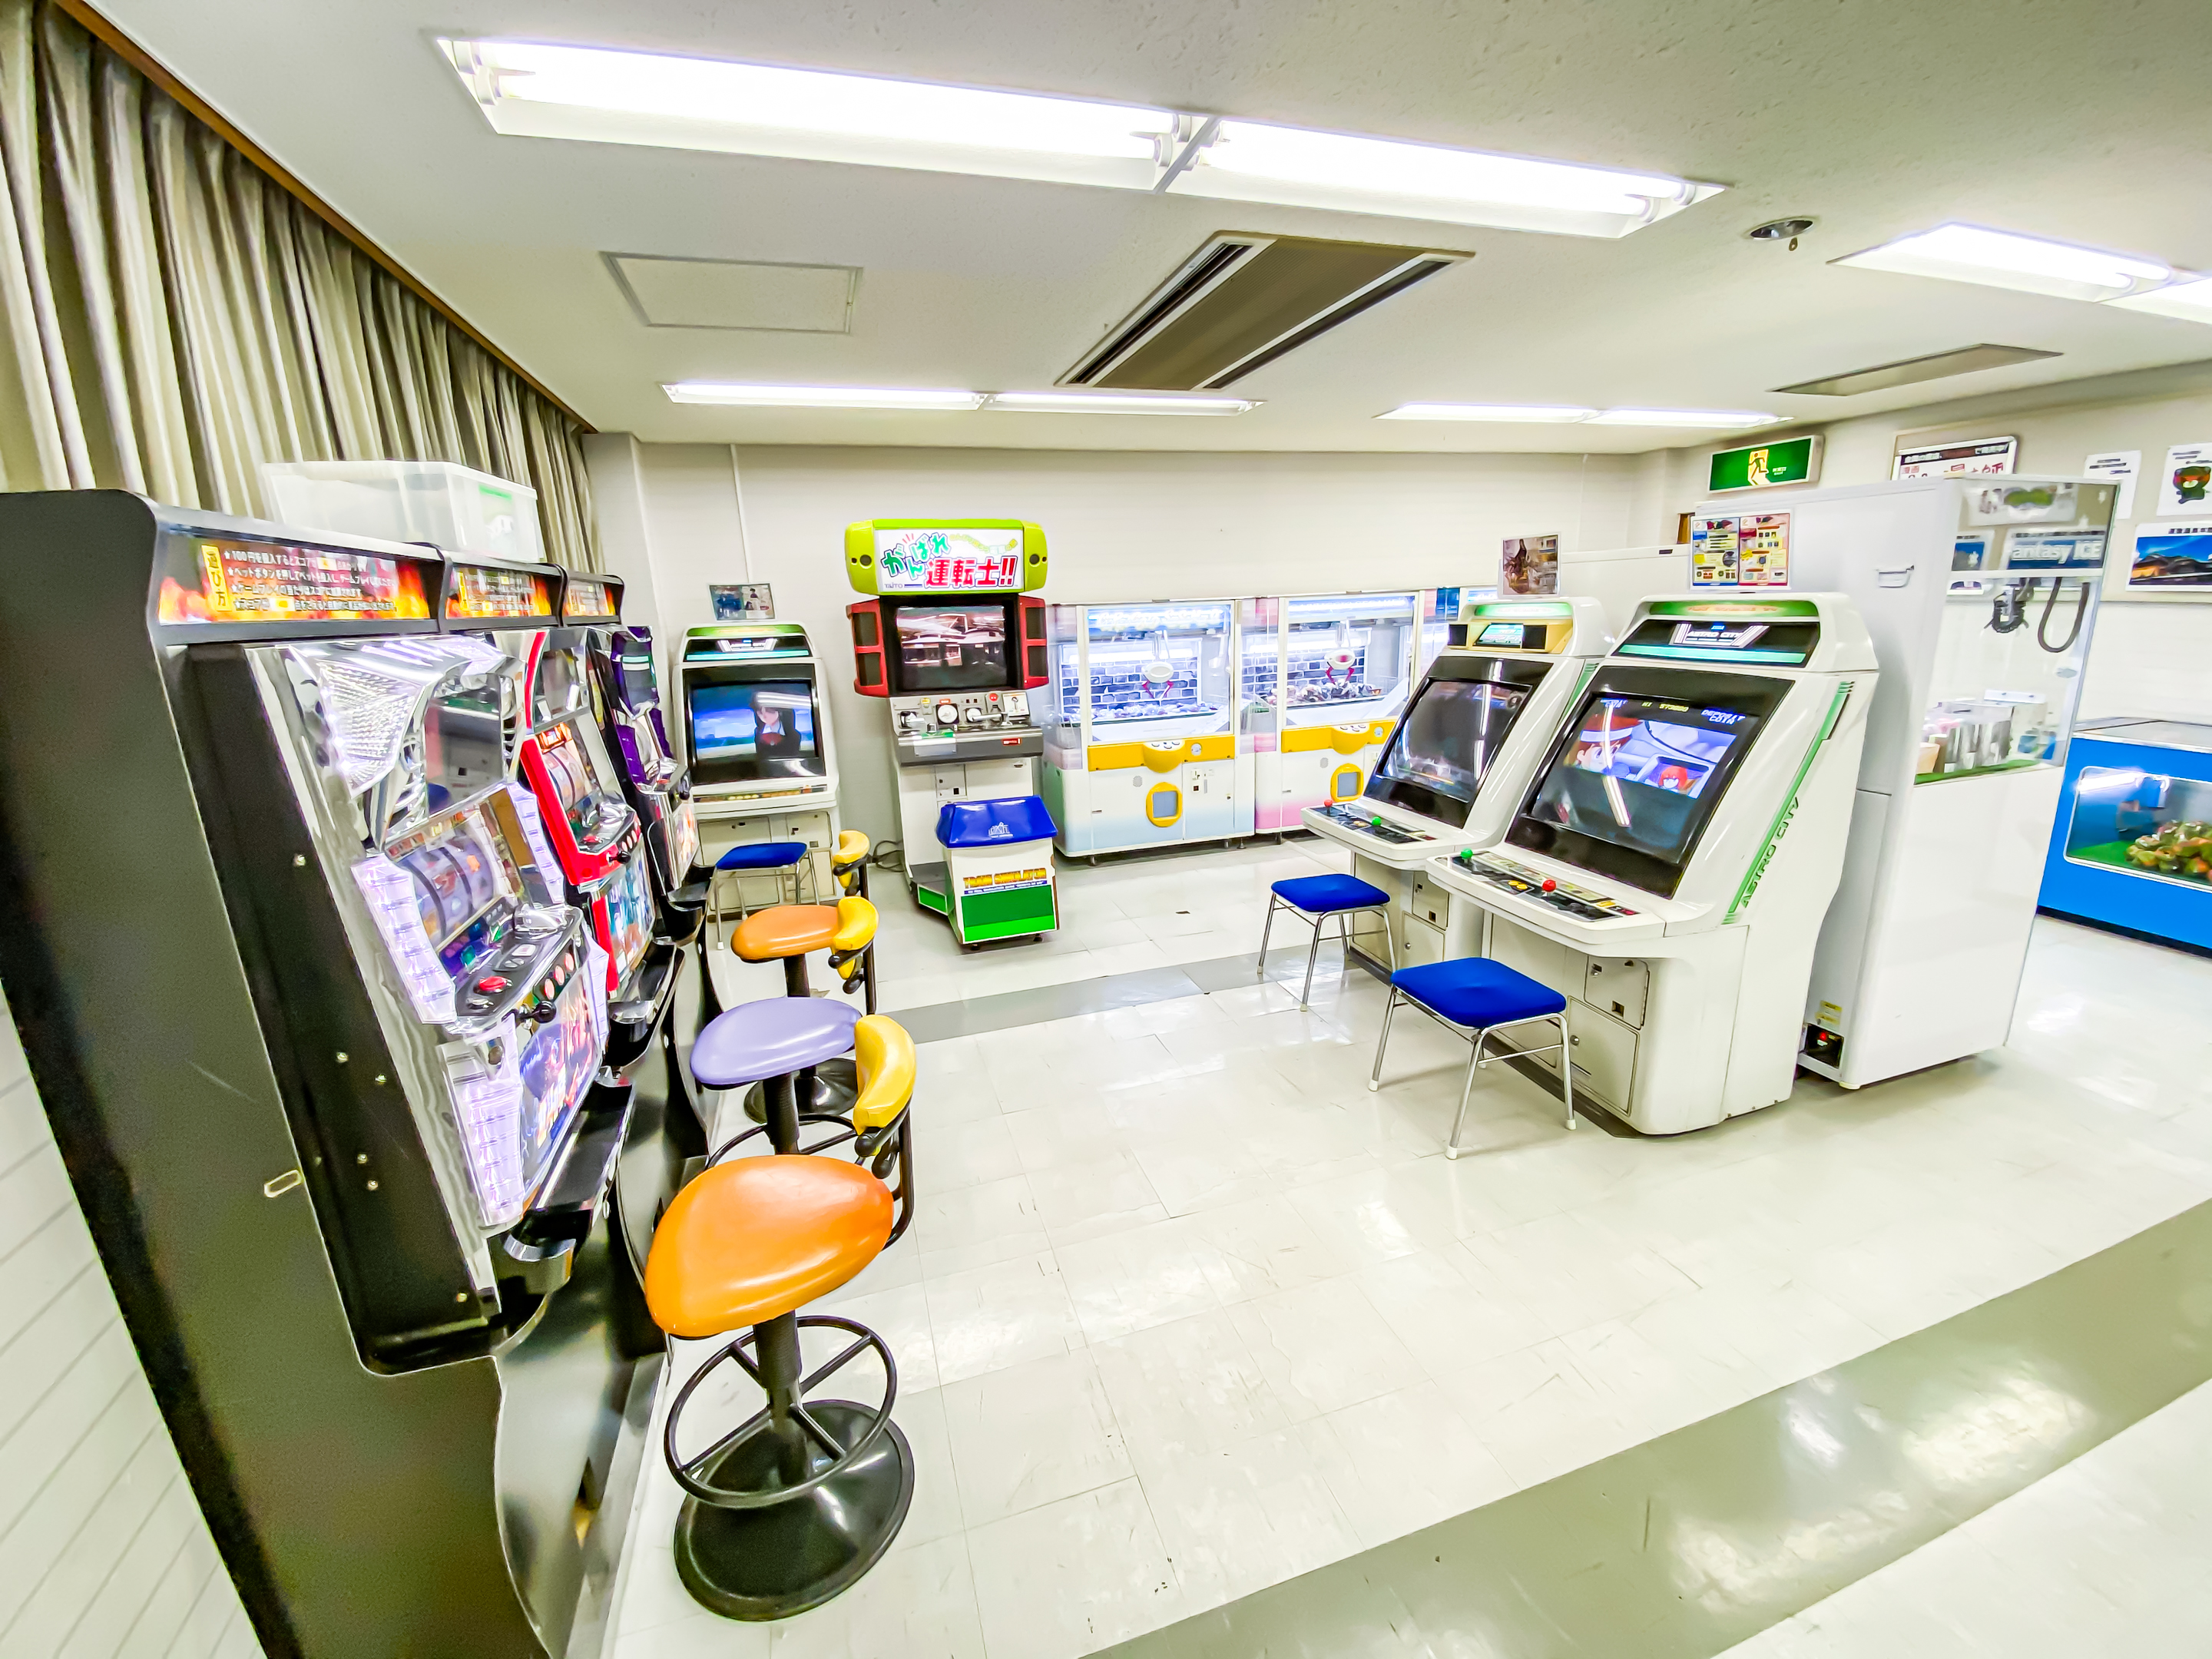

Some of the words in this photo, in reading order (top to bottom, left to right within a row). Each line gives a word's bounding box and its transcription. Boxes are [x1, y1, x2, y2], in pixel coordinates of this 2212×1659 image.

[881, 531, 952, 580] がんばれ
[2073, 540, 2102, 561] ICE
[924, 555, 1018, 588] 運転士!!
[1740, 844, 1777, 908] ASTRO
[1774, 796, 1799, 840] CITY
